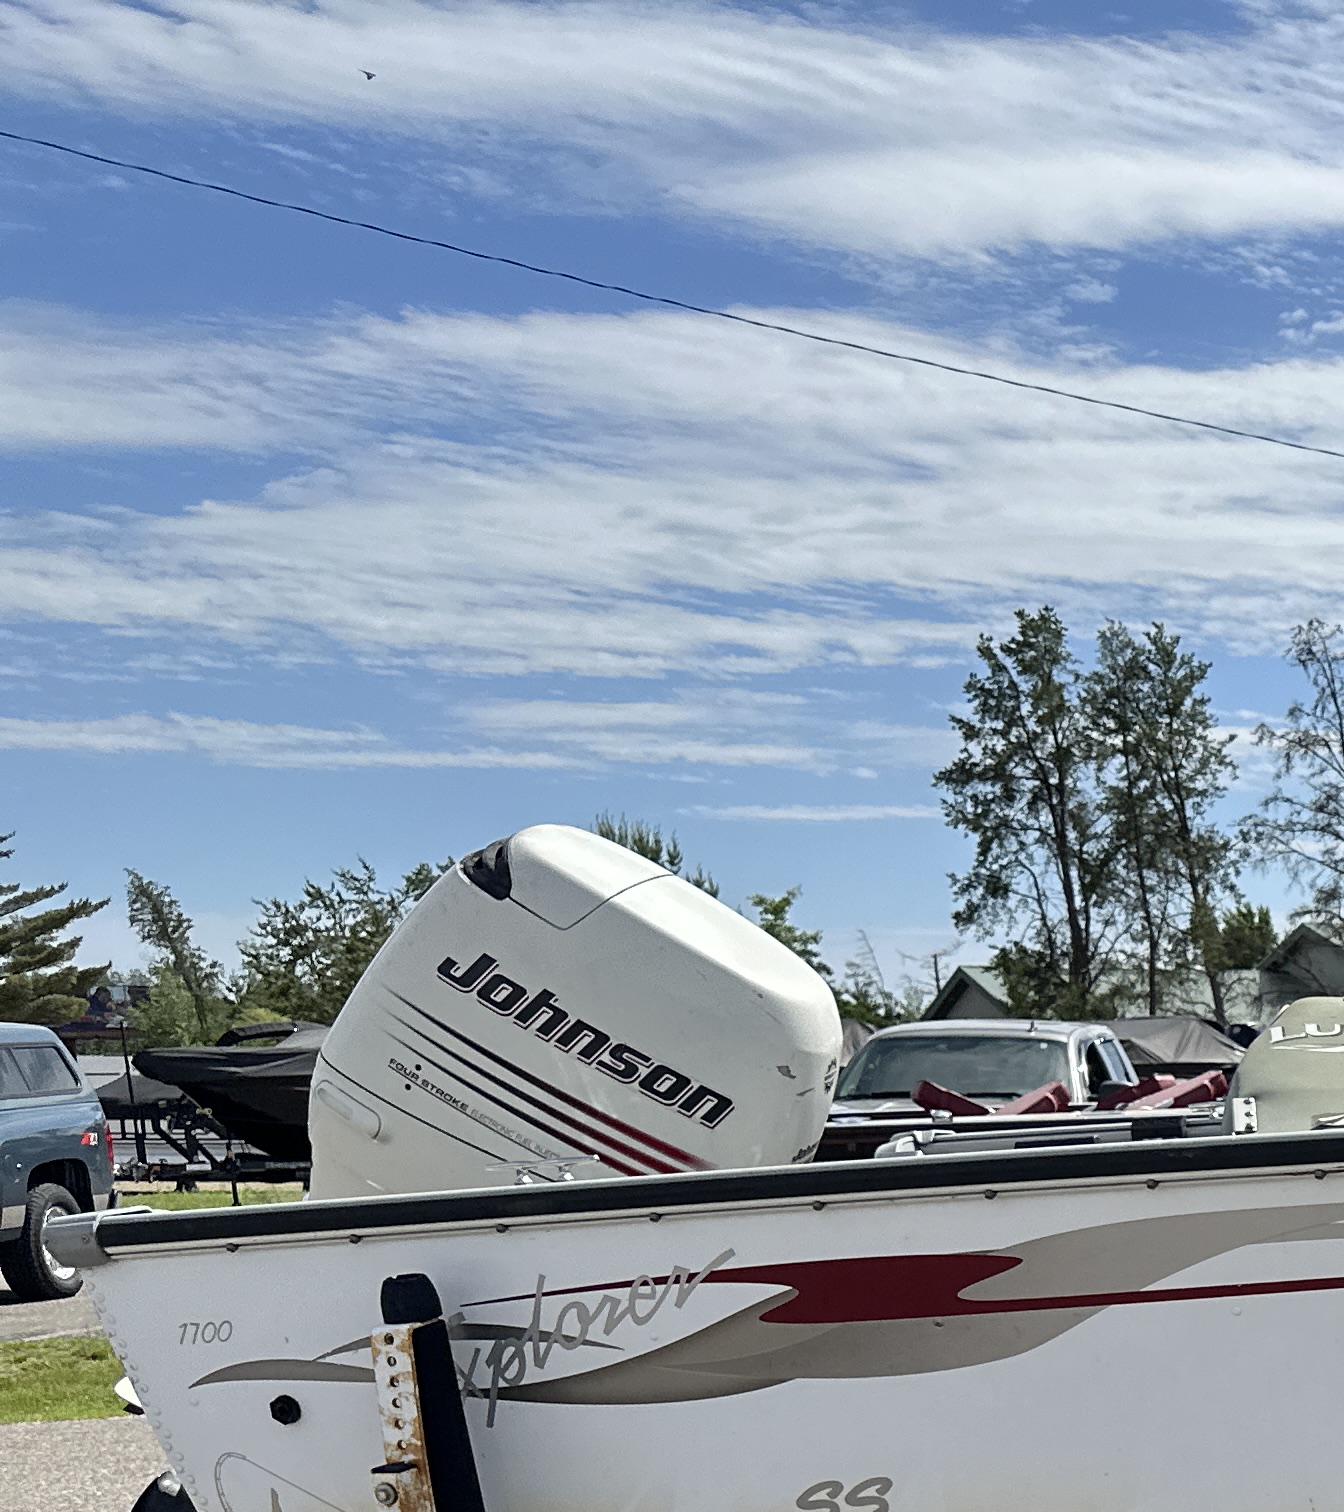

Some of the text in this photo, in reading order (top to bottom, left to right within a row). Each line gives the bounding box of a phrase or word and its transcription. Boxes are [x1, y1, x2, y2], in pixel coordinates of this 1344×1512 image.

[388, 1058, 420, 1083] FOUR
[421, 1078, 469, 1113] STROKE
[436, 952, 736, 1130] Johnson
[178, 1320, 234, 1345] 1700
[447, 1247, 737, 1429] xplorer
